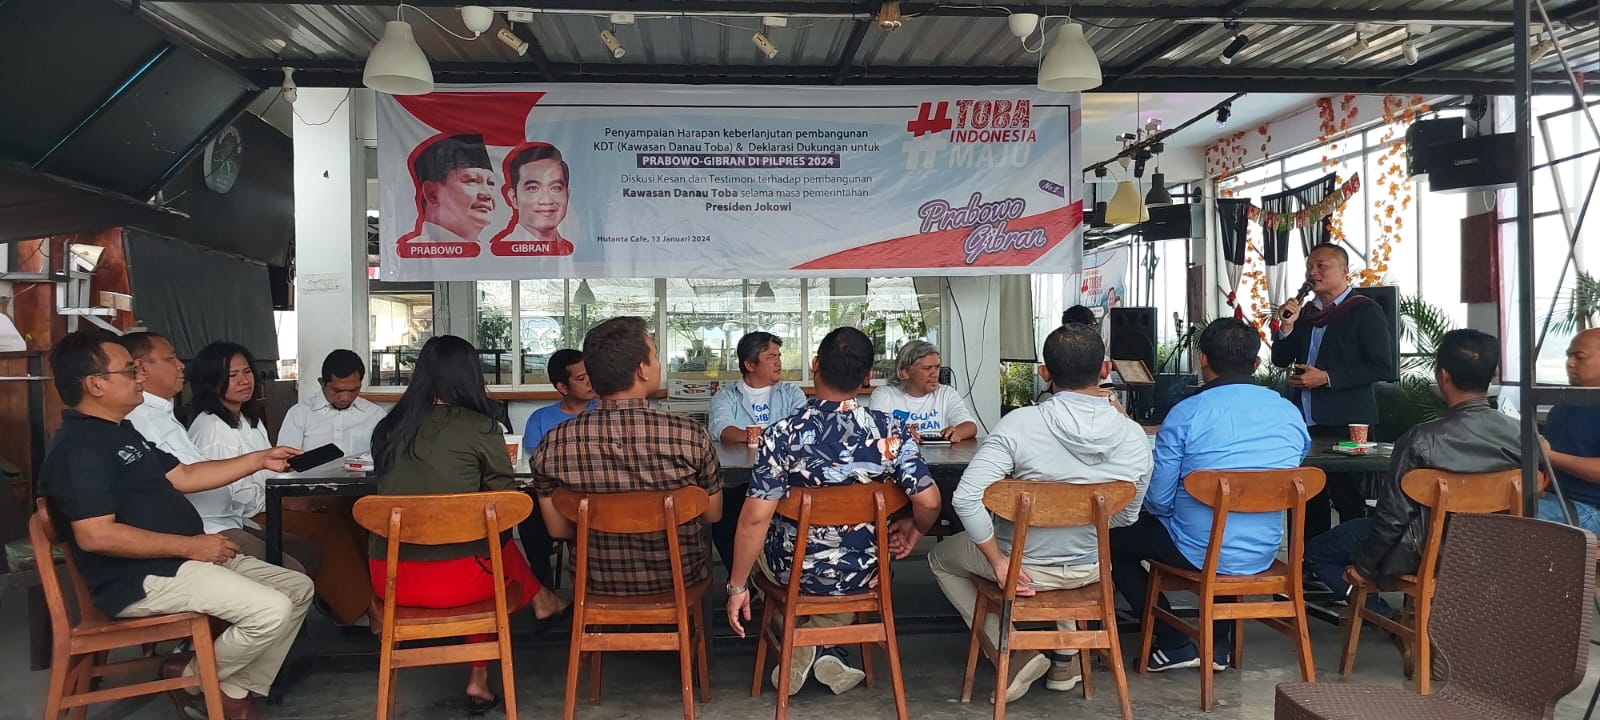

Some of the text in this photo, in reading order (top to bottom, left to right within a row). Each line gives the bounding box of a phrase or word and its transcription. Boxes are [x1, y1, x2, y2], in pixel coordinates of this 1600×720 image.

[956, 100, 1030, 129] TOBA
[605, 128, 869, 140] Penyampaian Harapan keberlanjutan pembangunan
[950, 130, 1037, 142] INDONESIA
[594, 142, 881, 154] KDT (Kawasan Danau Toba) & Deklarasi Dukungan untuk
[642, 157, 835, 166] PRABOWO-GIBRAN DI PILPRES 2024
[949, 143, 1032, 168] MAJU
[621, 174, 873, 186] Diskusi Kesan dan Testimoni terhadap pembangunan
[623, 189, 672, 198] Kawasan
[674, 189, 709, 198] Danau
[711, 189, 739, 198] Toba
[740, 188, 774, 198] selama
[803, 188, 869, 199] pemerintahan
[706, 202, 793, 211] Presiden Jokowi
[918, 192, 1025, 233] Prabowo
[630, 236, 650, 244] Cafe,
[964, 222, 1047, 264] Gibran
[410, 246, 463, 256] PRABOWO
[511, 244, 550, 254] GIBRAN
